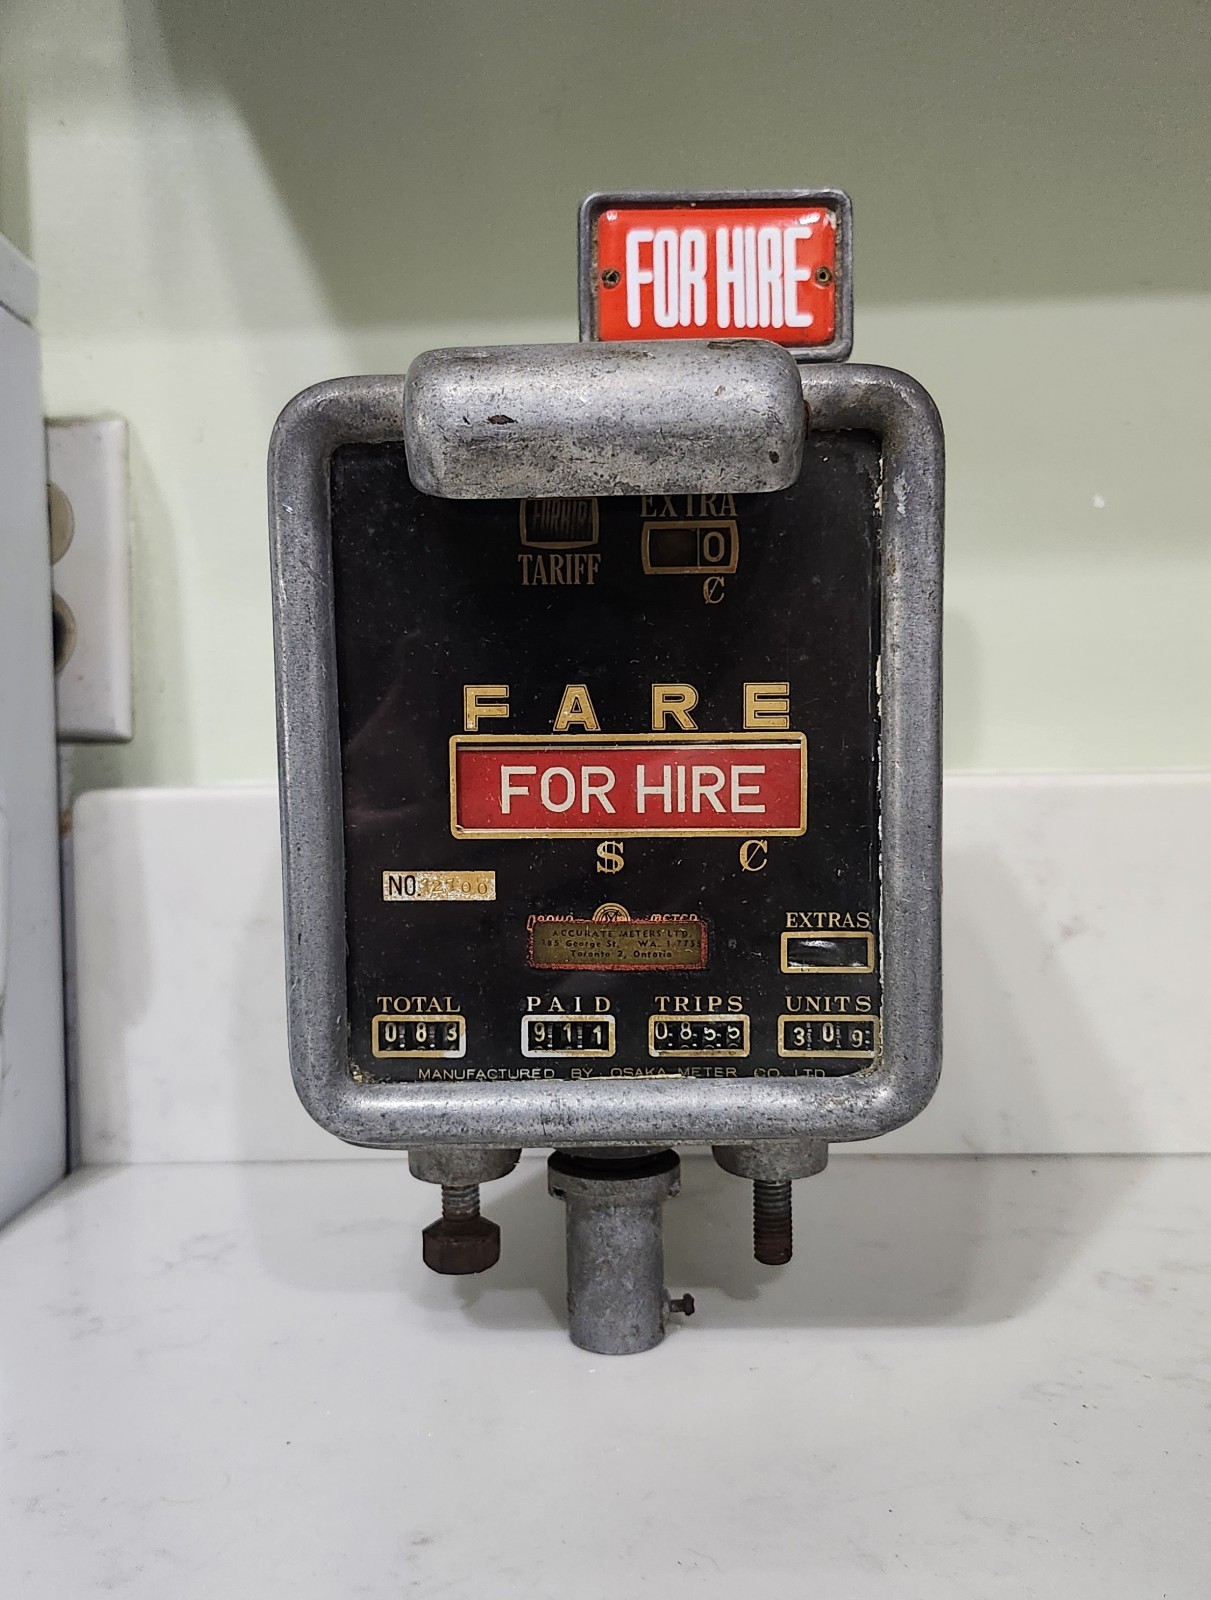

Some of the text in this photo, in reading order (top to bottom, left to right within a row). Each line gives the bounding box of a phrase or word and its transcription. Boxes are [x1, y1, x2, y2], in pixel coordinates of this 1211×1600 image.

[626, 226, 814, 328] FOR HIRE
[640, 494, 739, 517] EXTRA
[518, 553, 601, 585] TARIFF
[463, 682, 790, 732] FARE
[501, 764, 766, 813] FOR HIRE
[596, 841, 624, 873] $
[785, 911, 870, 928] EXTRAS
[552, 929, 692, 938] ACCURATE METERS LTD.
[565, 939, 602, 949] George
[571, 950, 610, 958] Toronto
[633, 950, 673, 958] Ontario
[377, 996, 461, 1012] TOTAL
[526, 996, 611, 1012] PAID
[655, 996, 743, 1012] TRIPS
[786, 996, 872, 1012] UNITS
[418, 1068, 554, 1079] MANUFACTURED
[571, 1068, 593, 1078] BY
[610, 1067, 667, 1077] OSAKA
[678, 1067, 737, 1078] METER
